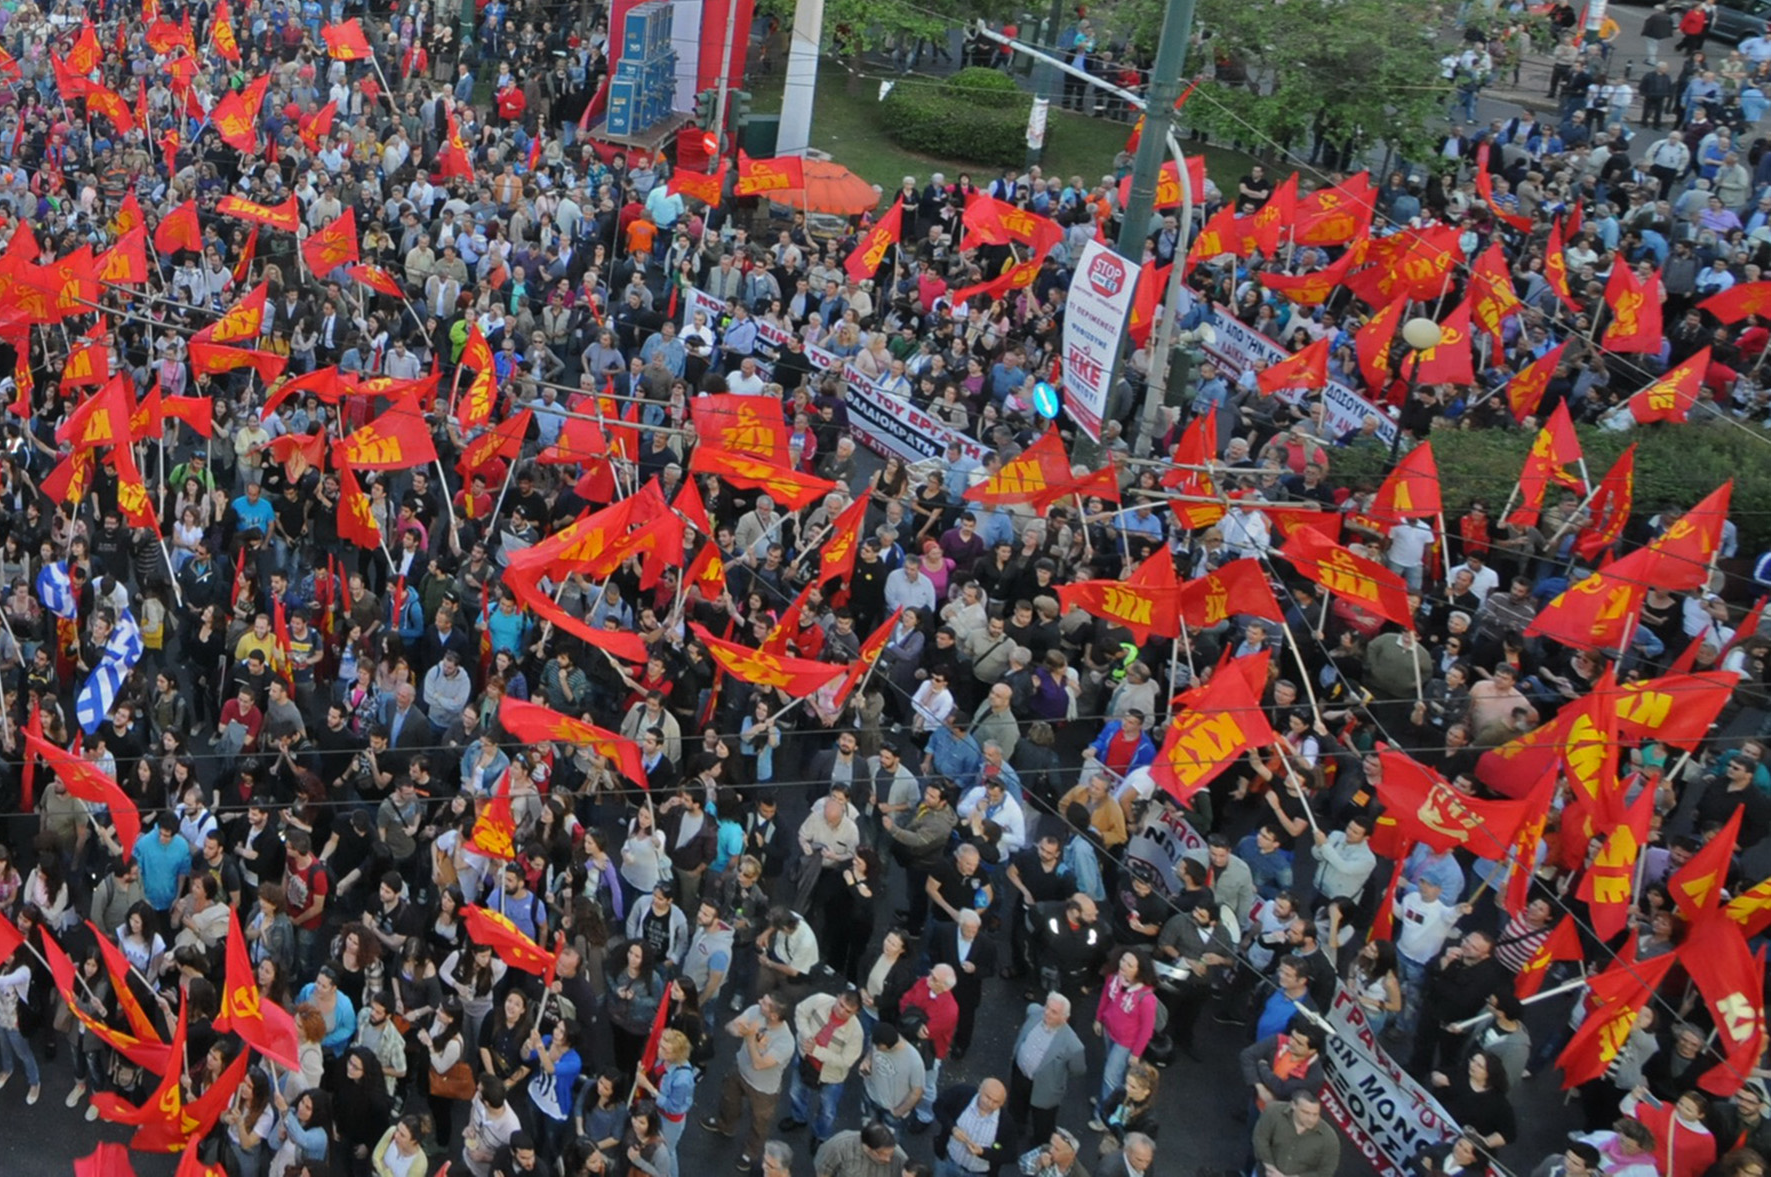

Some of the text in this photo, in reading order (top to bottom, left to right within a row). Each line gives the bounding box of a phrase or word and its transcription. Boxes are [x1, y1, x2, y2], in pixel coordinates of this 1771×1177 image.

[1094, 258, 1122, 280] STOP
[1226, 322, 1244, 342] ΑΠΟ
[811, 349, 831, 367] ΤΟ
[876, 392, 905, 416] ΤΟΥ
[1069, 348, 1102, 389] ΚΚΕ
[1325, 383, 1375, 420] ΔΩΣΟΥΜ
